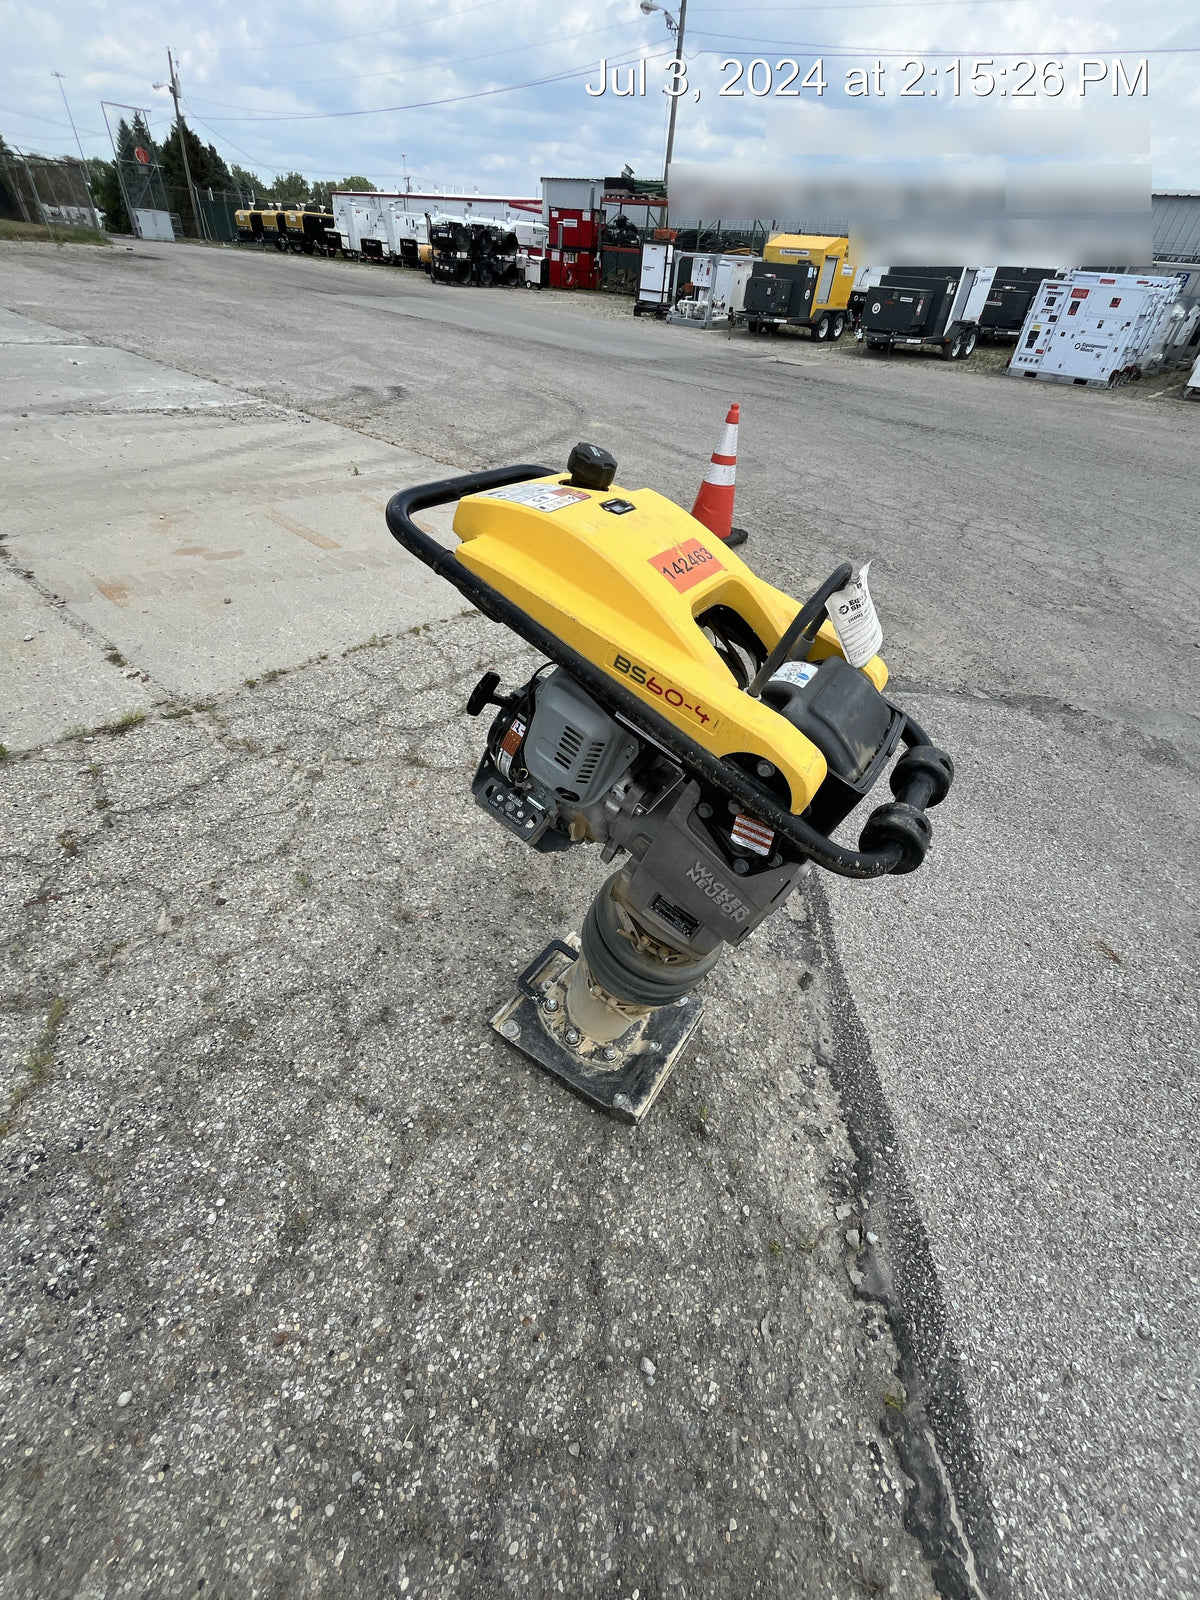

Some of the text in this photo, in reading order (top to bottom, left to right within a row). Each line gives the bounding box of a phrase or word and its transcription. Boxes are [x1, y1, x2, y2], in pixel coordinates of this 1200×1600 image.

[662, 547, 713, 580] 142463
[613, 655, 710, 724] BS60-4
[686, 867, 746, 923] NEUSON
[693, 860, 750, 919] WACKER
